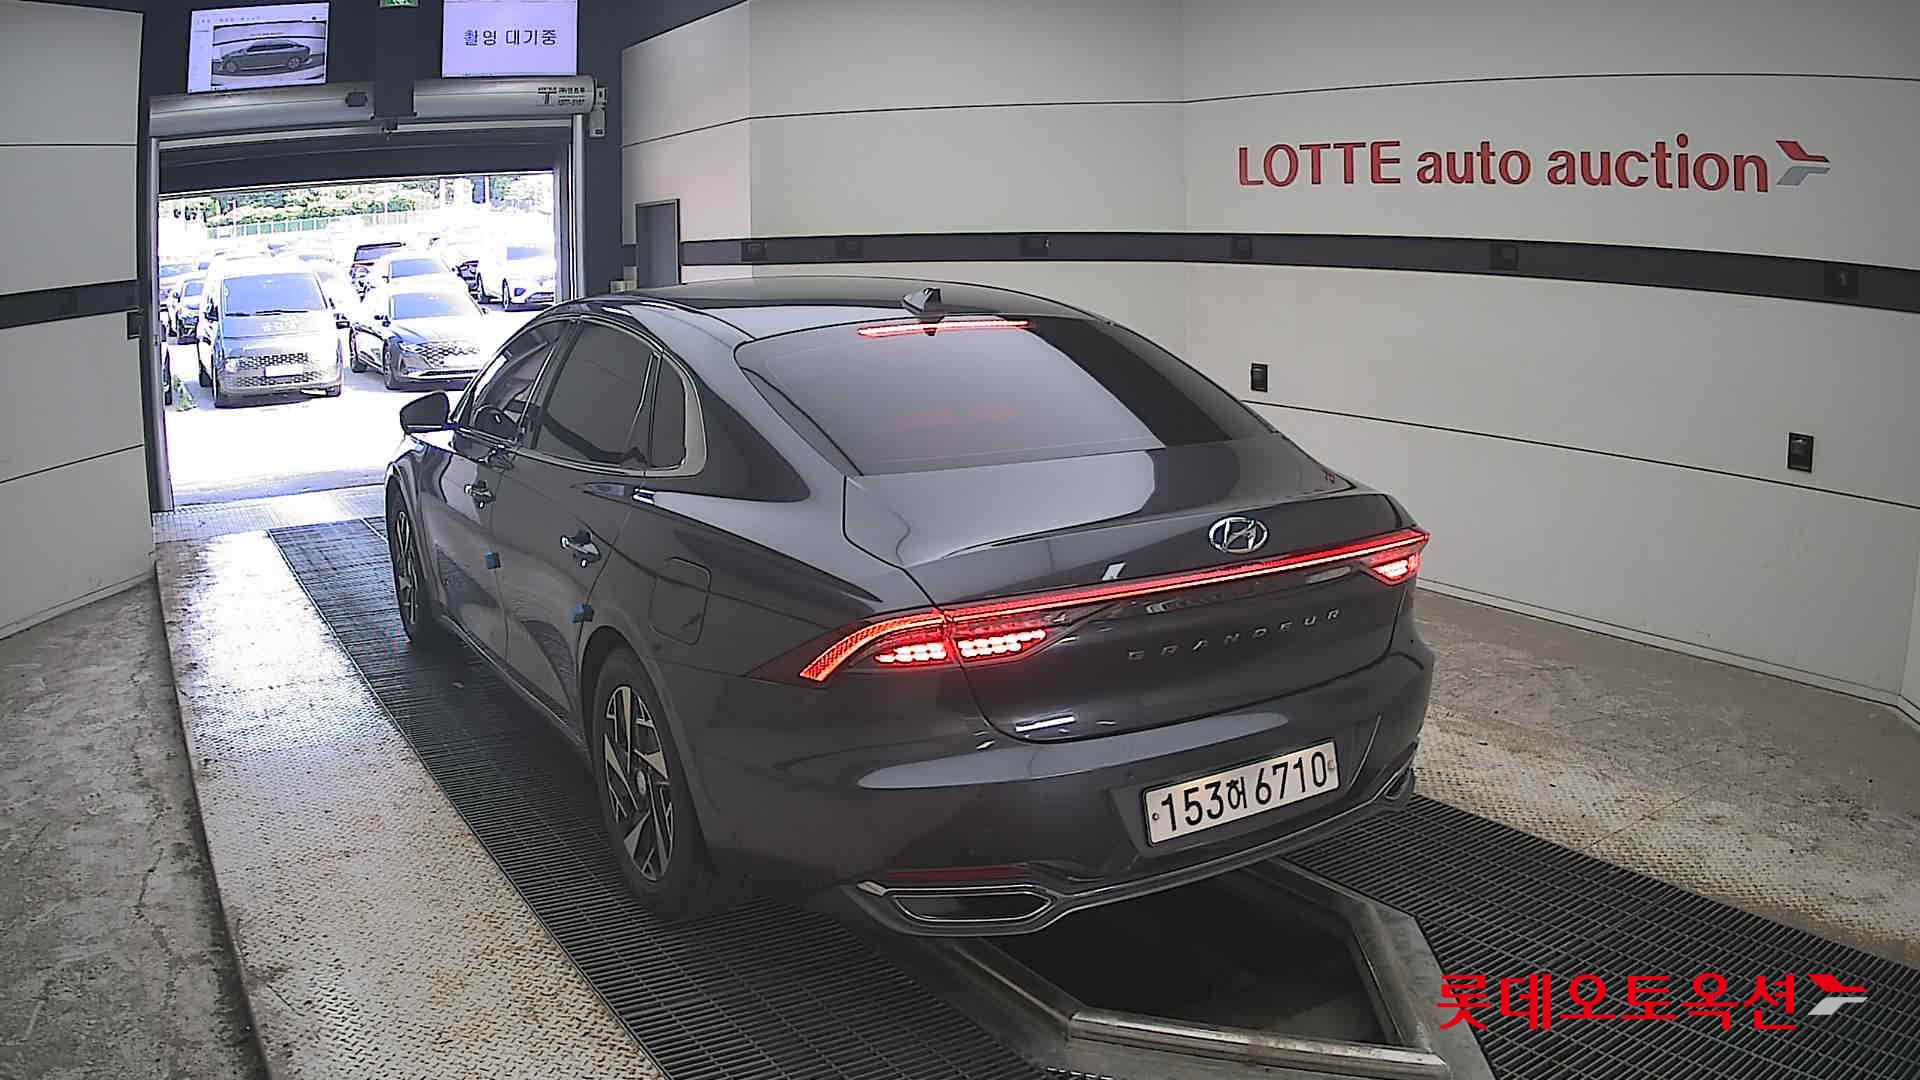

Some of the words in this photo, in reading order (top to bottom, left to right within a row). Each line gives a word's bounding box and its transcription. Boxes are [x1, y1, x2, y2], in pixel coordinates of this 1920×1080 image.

[505, 28, 558, 46] 대기중
[1238, 140, 1401, 187] LOTTE
[1416, 140, 1531, 185] auto
[1546, 132, 1769, 193] auction
[1127, 607, 1341, 661] GRANDEUR
